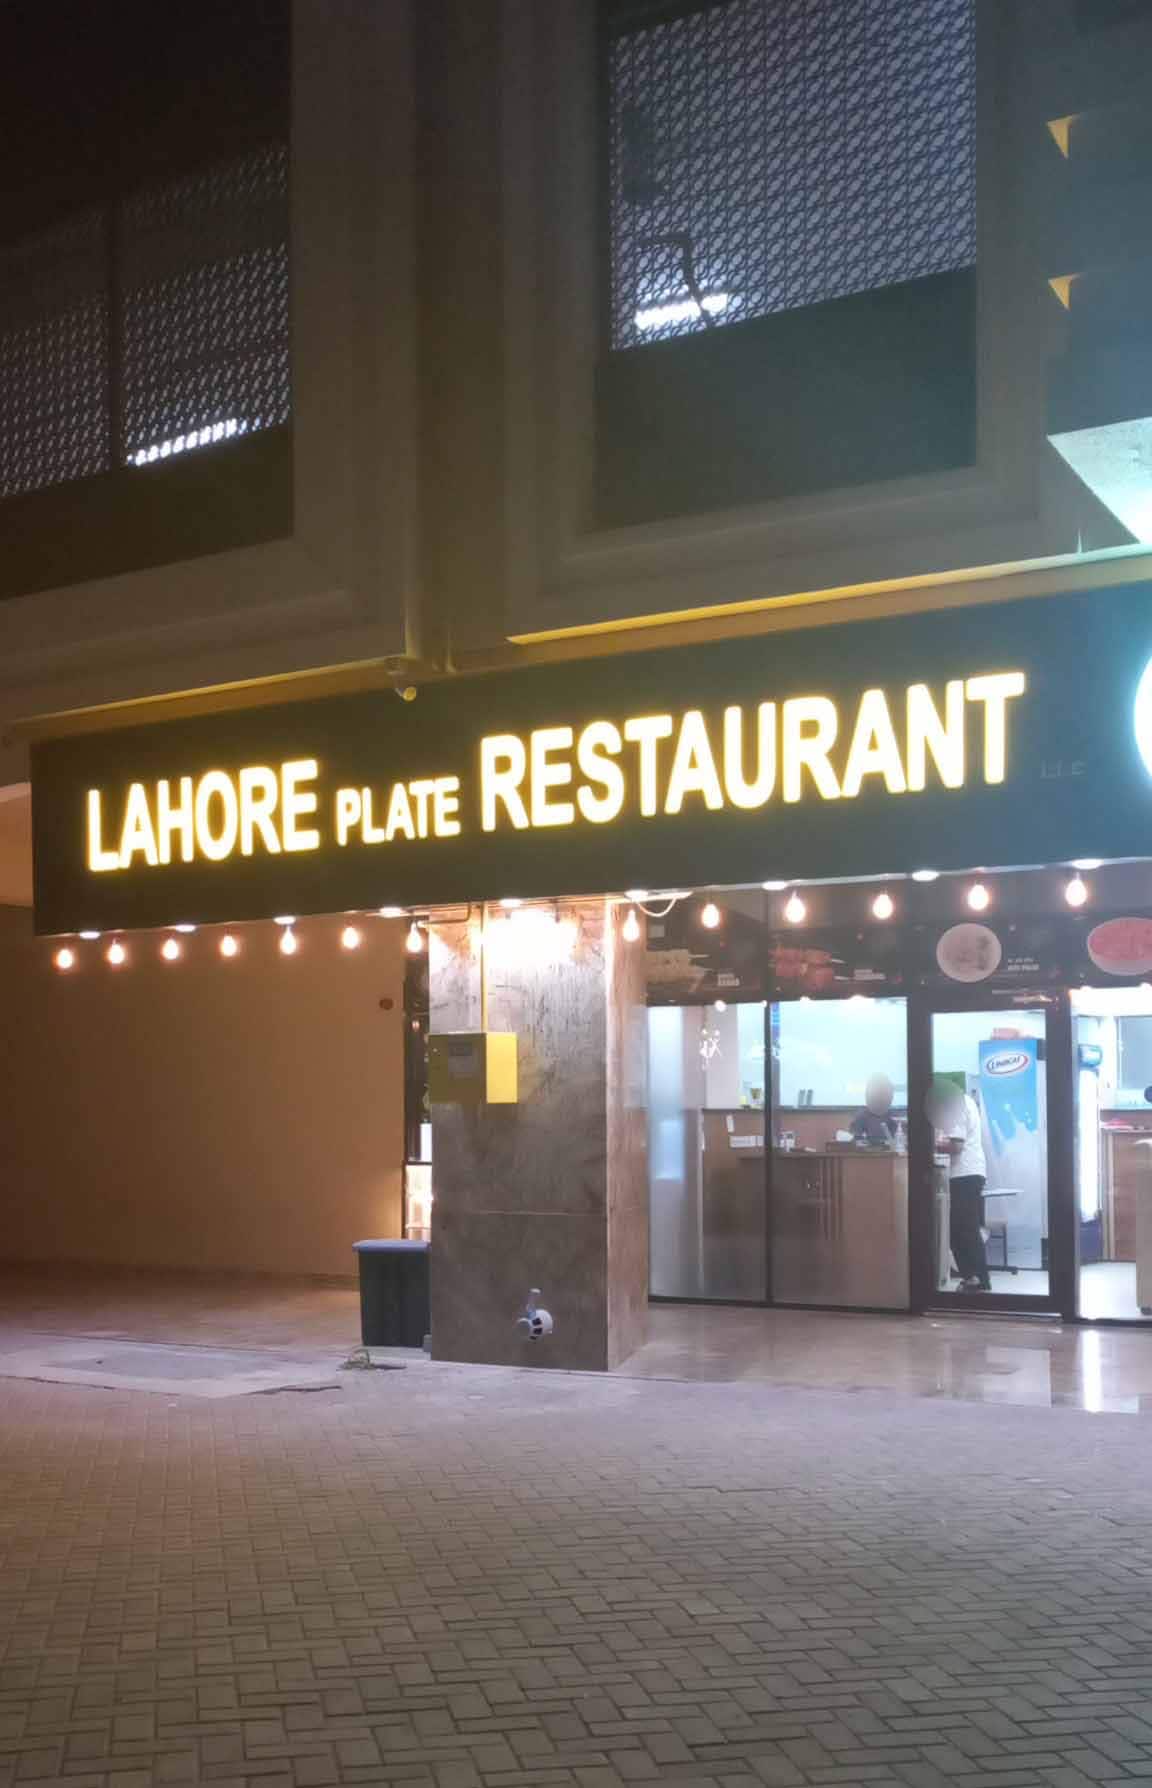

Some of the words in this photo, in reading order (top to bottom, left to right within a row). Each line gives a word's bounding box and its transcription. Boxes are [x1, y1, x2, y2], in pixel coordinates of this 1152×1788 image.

[87, 758, 320, 872] LAHORE
[336, 776, 461, 847] PLATE
[480, 671, 1026, 832] RESTAURANT
